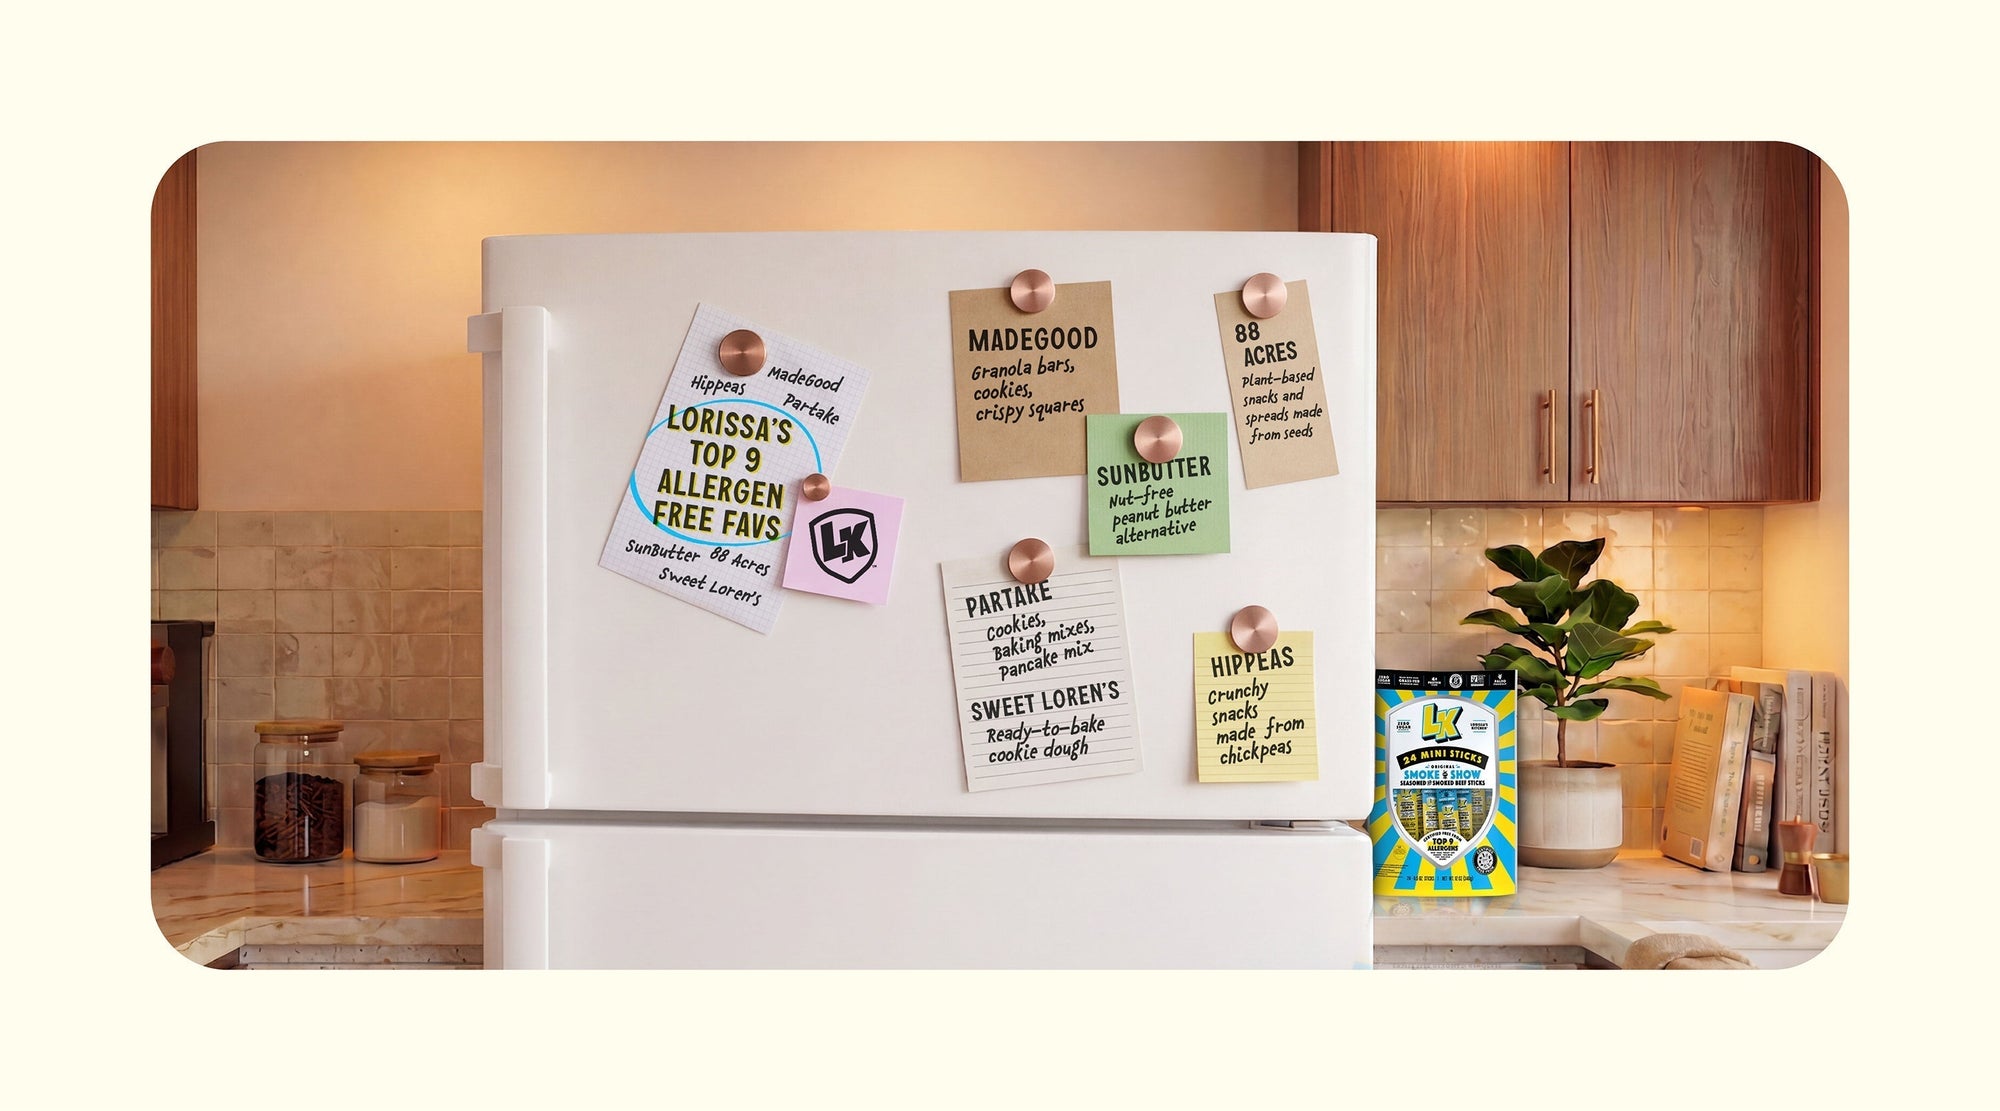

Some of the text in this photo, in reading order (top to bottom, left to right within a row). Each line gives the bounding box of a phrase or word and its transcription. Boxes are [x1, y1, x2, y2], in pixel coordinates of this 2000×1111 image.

[969, 327, 1098, 352] MADEGOOD
[1235, 322, 1260, 343] 88
[1244, 341, 1298, 367] ACRES
[691, 366, 845, 396] Hippeas MadeGood
[972, 356, 1075, 381] Granola bars,
[974, 381, 1033, 400] cookies,
[1243, 386, 1305, 407] snacks and
[782, 393, 840, 426] Partake
[976, 398, 1085, 424] crispy squares
[1245, 403, 1323, 428] spreads made
[667, 404, 793, 444] LORISSA'S
[1249, 423, 1313, 445] from seeds
[690, 440, 761, 473] TOP 9
[1097, 456, 1211, 487] SUNBUTTER
[657, 469, 784, 510] ALLERGEN
[653, 500, 782, 540] FREE FAVS
[1113, 498, 1212, 532] peanut butter
[1116, 520, 1196, 545] alternative
[626, 540, 771, 577] SunButter 88 Acres
[659, 567, 762, 606] Sweet Loren's
[965, 580, 1053, 619] PARTAKE
[987, 613, 1046, 641] Cookies,
[993, 620, 1095, 661] Baking mixes,
[999, 640, 1094, 681] Pancake mix
[1211, 646, 1294, 678] HIPPEAS
[971, 680, 1120, 722] SWEET LOREN'S
[1208, 677, 1269, 705] Crunchy
[1212, 700, 1258, 726] snacks
[1422, 703, 1463, 744] LK
[1217, 716, 1304, 745] made from
[988, 741, 1089, 764] cookie dough
[1220, 740, 1292, 764] chickpeas
[1403, 750, 1482, 765] 24 MINI STICKS
[1404, 770, 1481, 779] SMOKE SHOW
